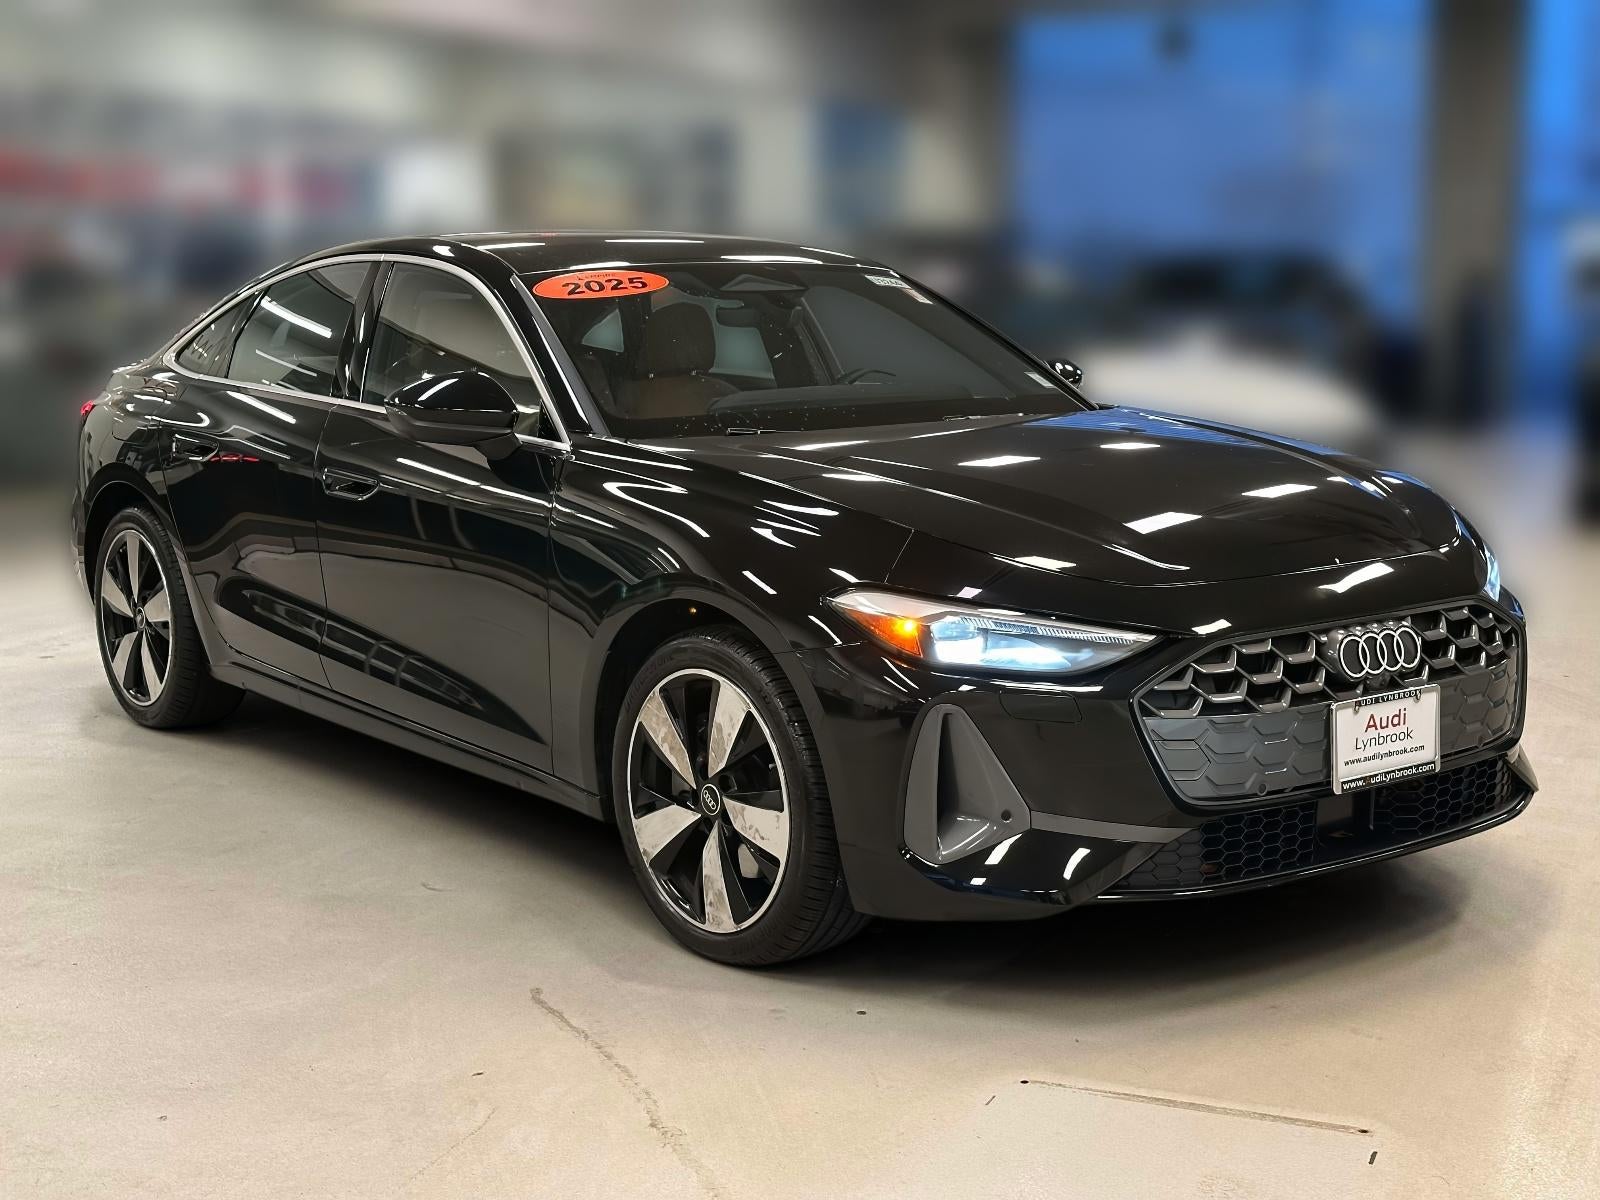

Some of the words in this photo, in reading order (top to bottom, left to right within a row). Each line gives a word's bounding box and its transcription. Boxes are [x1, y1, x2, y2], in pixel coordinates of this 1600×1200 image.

[562, 277, 648, 296] 2025
[1379, 689, 1422, 703] LYNBROOK
[1364, 707, 1407, 733] Audi
[1355, 727, 1414, 752] Lynbrook
[1343, 744, 1425, 766] www.audilynbrook.com
